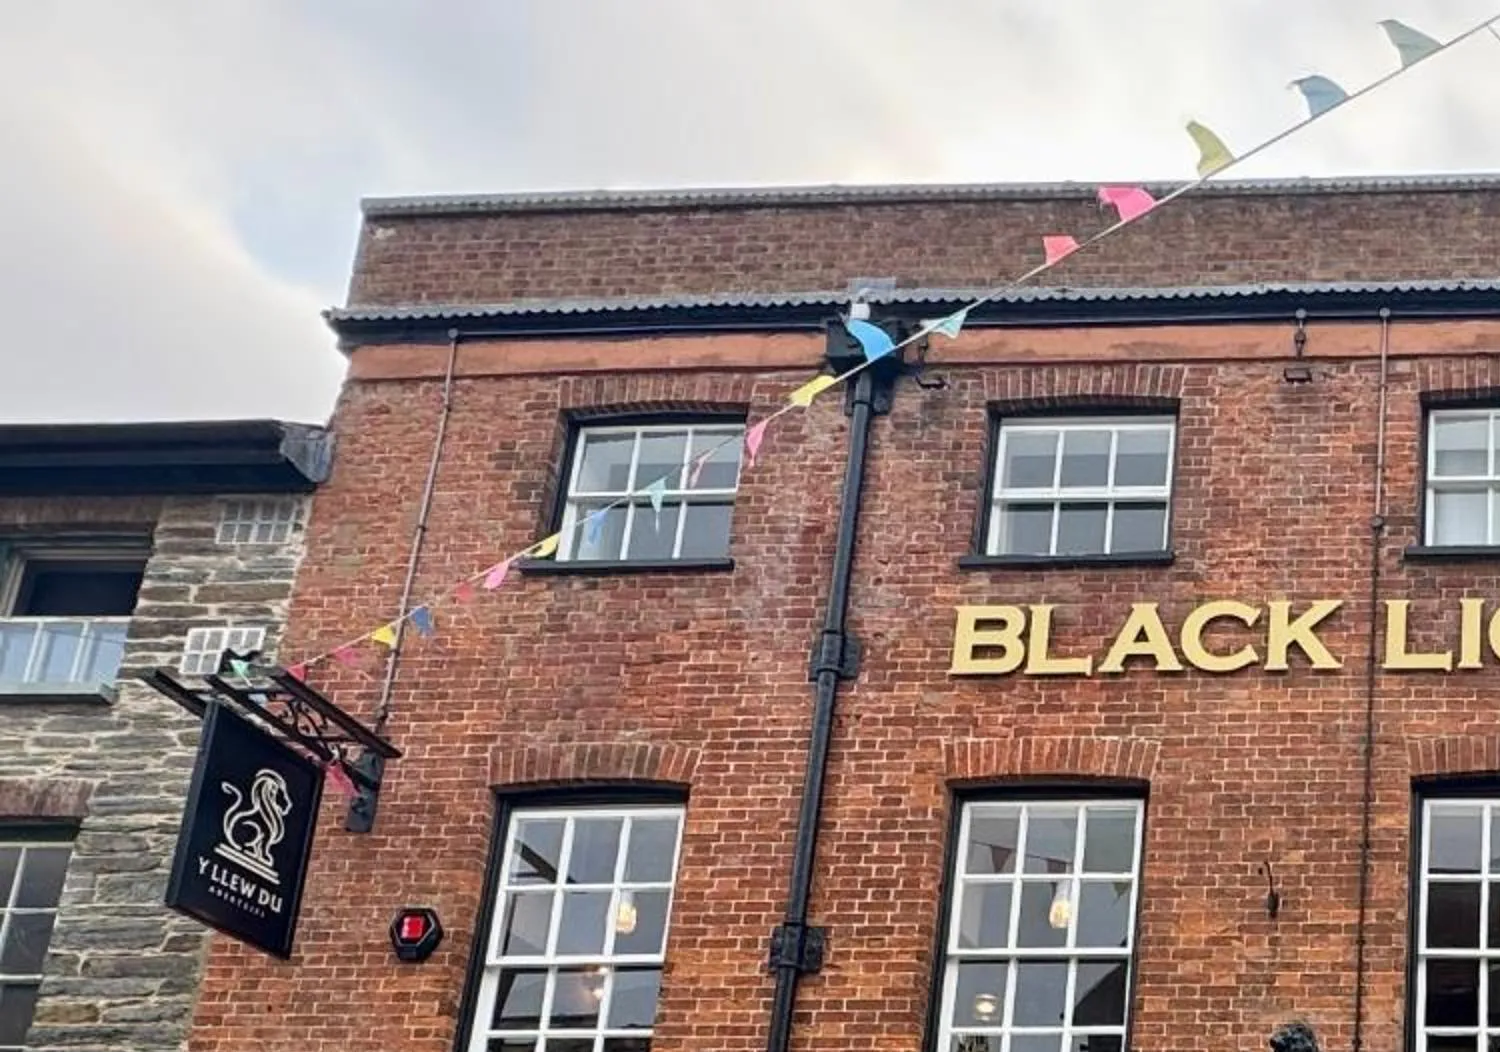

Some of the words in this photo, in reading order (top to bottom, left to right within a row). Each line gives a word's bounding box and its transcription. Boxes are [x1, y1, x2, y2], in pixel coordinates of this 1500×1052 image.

[948, 600, 1345, 677] BLACK
[199, 856, 211, 875] Y
[211, 864, 257, 899] LLEW
[258, 888, 283, 913] DU
